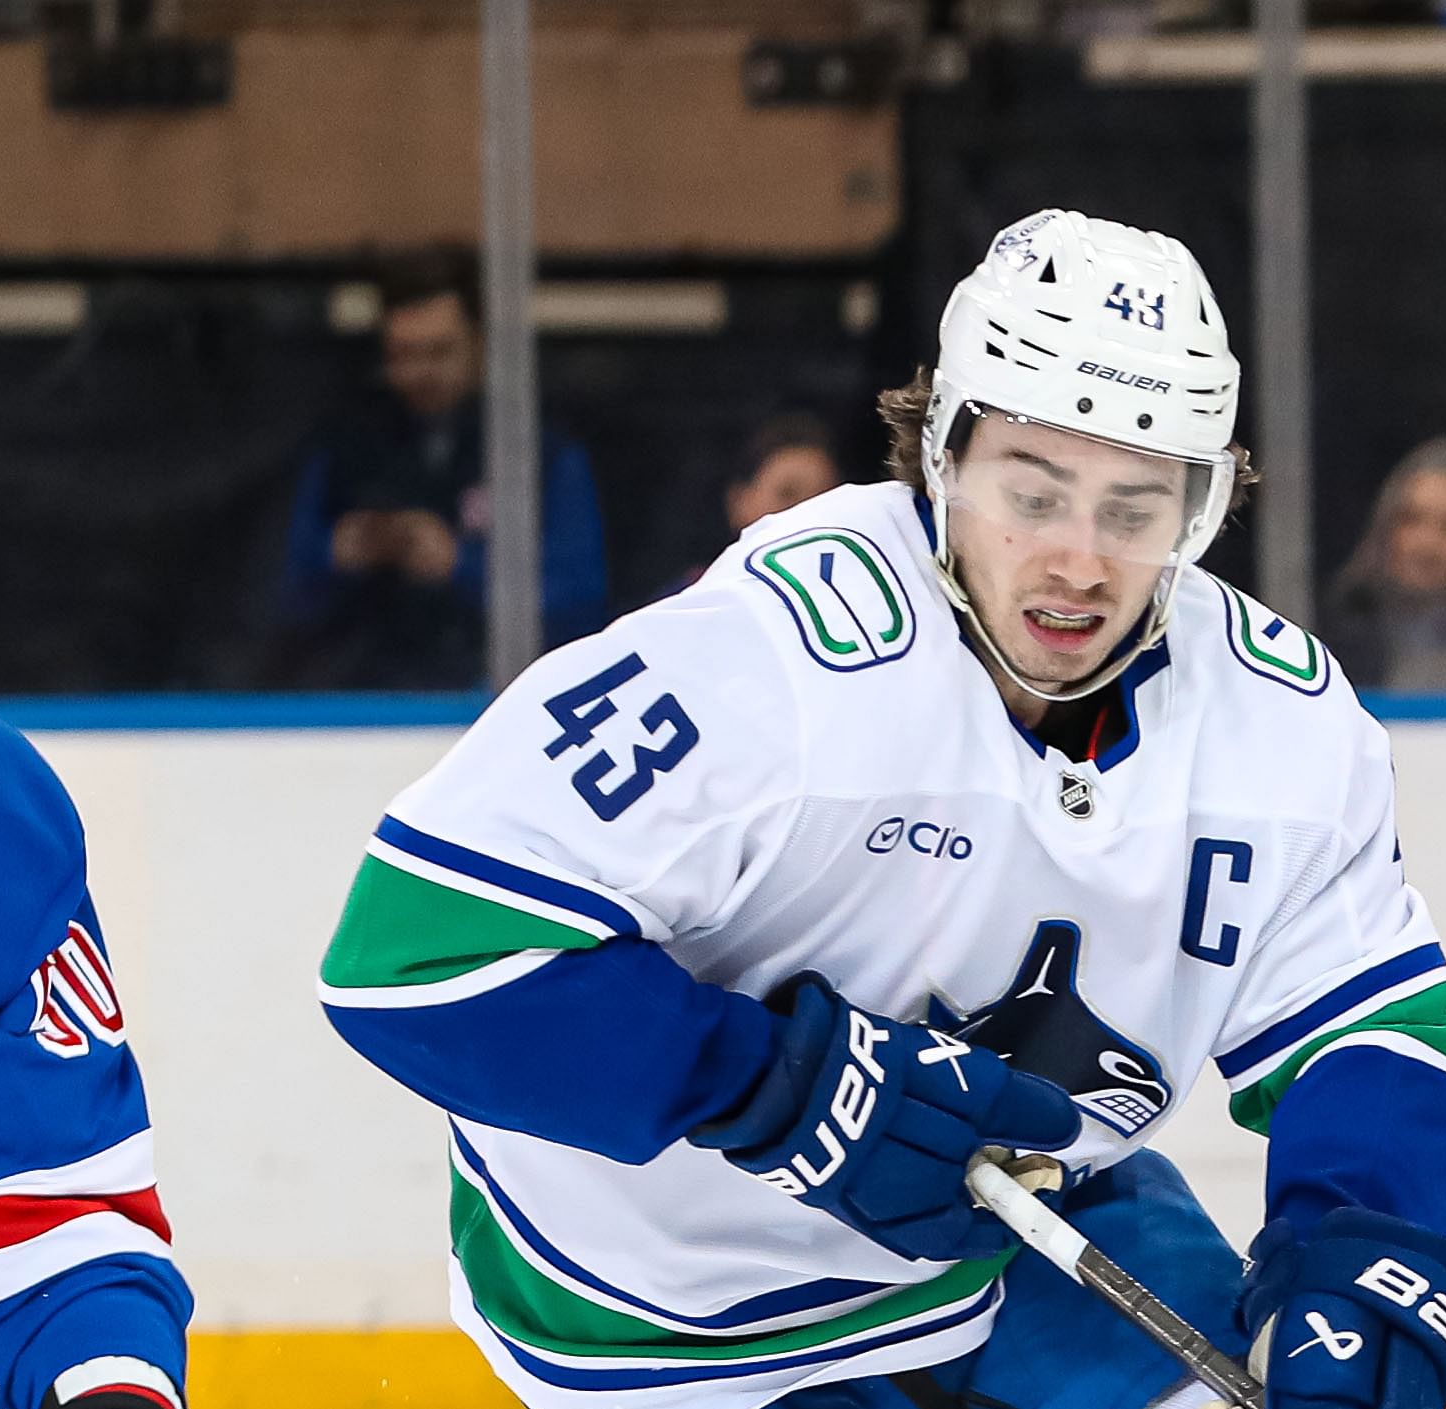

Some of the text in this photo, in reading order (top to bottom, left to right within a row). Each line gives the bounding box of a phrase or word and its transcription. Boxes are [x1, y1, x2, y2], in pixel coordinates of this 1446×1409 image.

[1103, 282, 1165, 331] 43
[542, 651, 701, 823] 43
[1063, 787, 1087, 807] NHL
[1180, 837, 1253, 967] C
[28, 919, 125, 1060] 50
